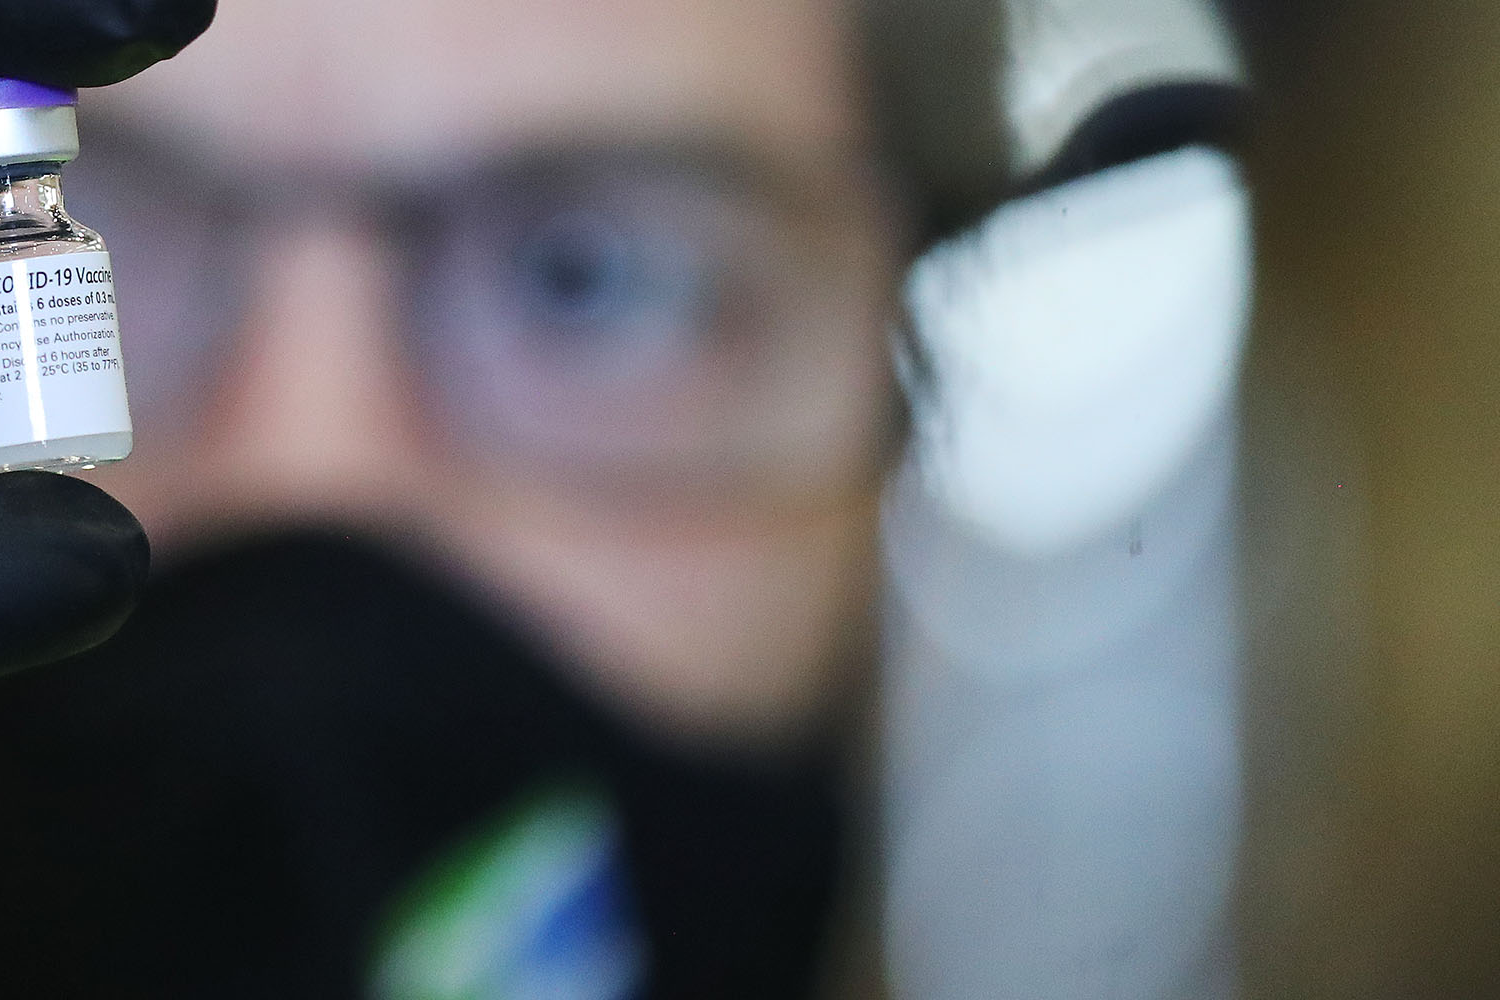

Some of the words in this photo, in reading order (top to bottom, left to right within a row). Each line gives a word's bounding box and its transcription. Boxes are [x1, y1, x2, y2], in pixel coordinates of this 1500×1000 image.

[36, 297, 45, 310] 6
[48, 295, 82, 309] doses
[84, 291, 94, 305] of
[50, 316, 65, 326] no
[36, 336, 50, 346] se
[2, 352, 48, 369] Discrd
[50, 351, 58, 362] 6
[61, 349, 91, 361] hours
[92, 346, 110, 358] after
[0, 372, 12, 383] at
[14, 369, 22, 381] 2
[41, 362, 69, 377] 25°C
[72, 361, 89, 374] (35
[91, 361, 101, 371] to
